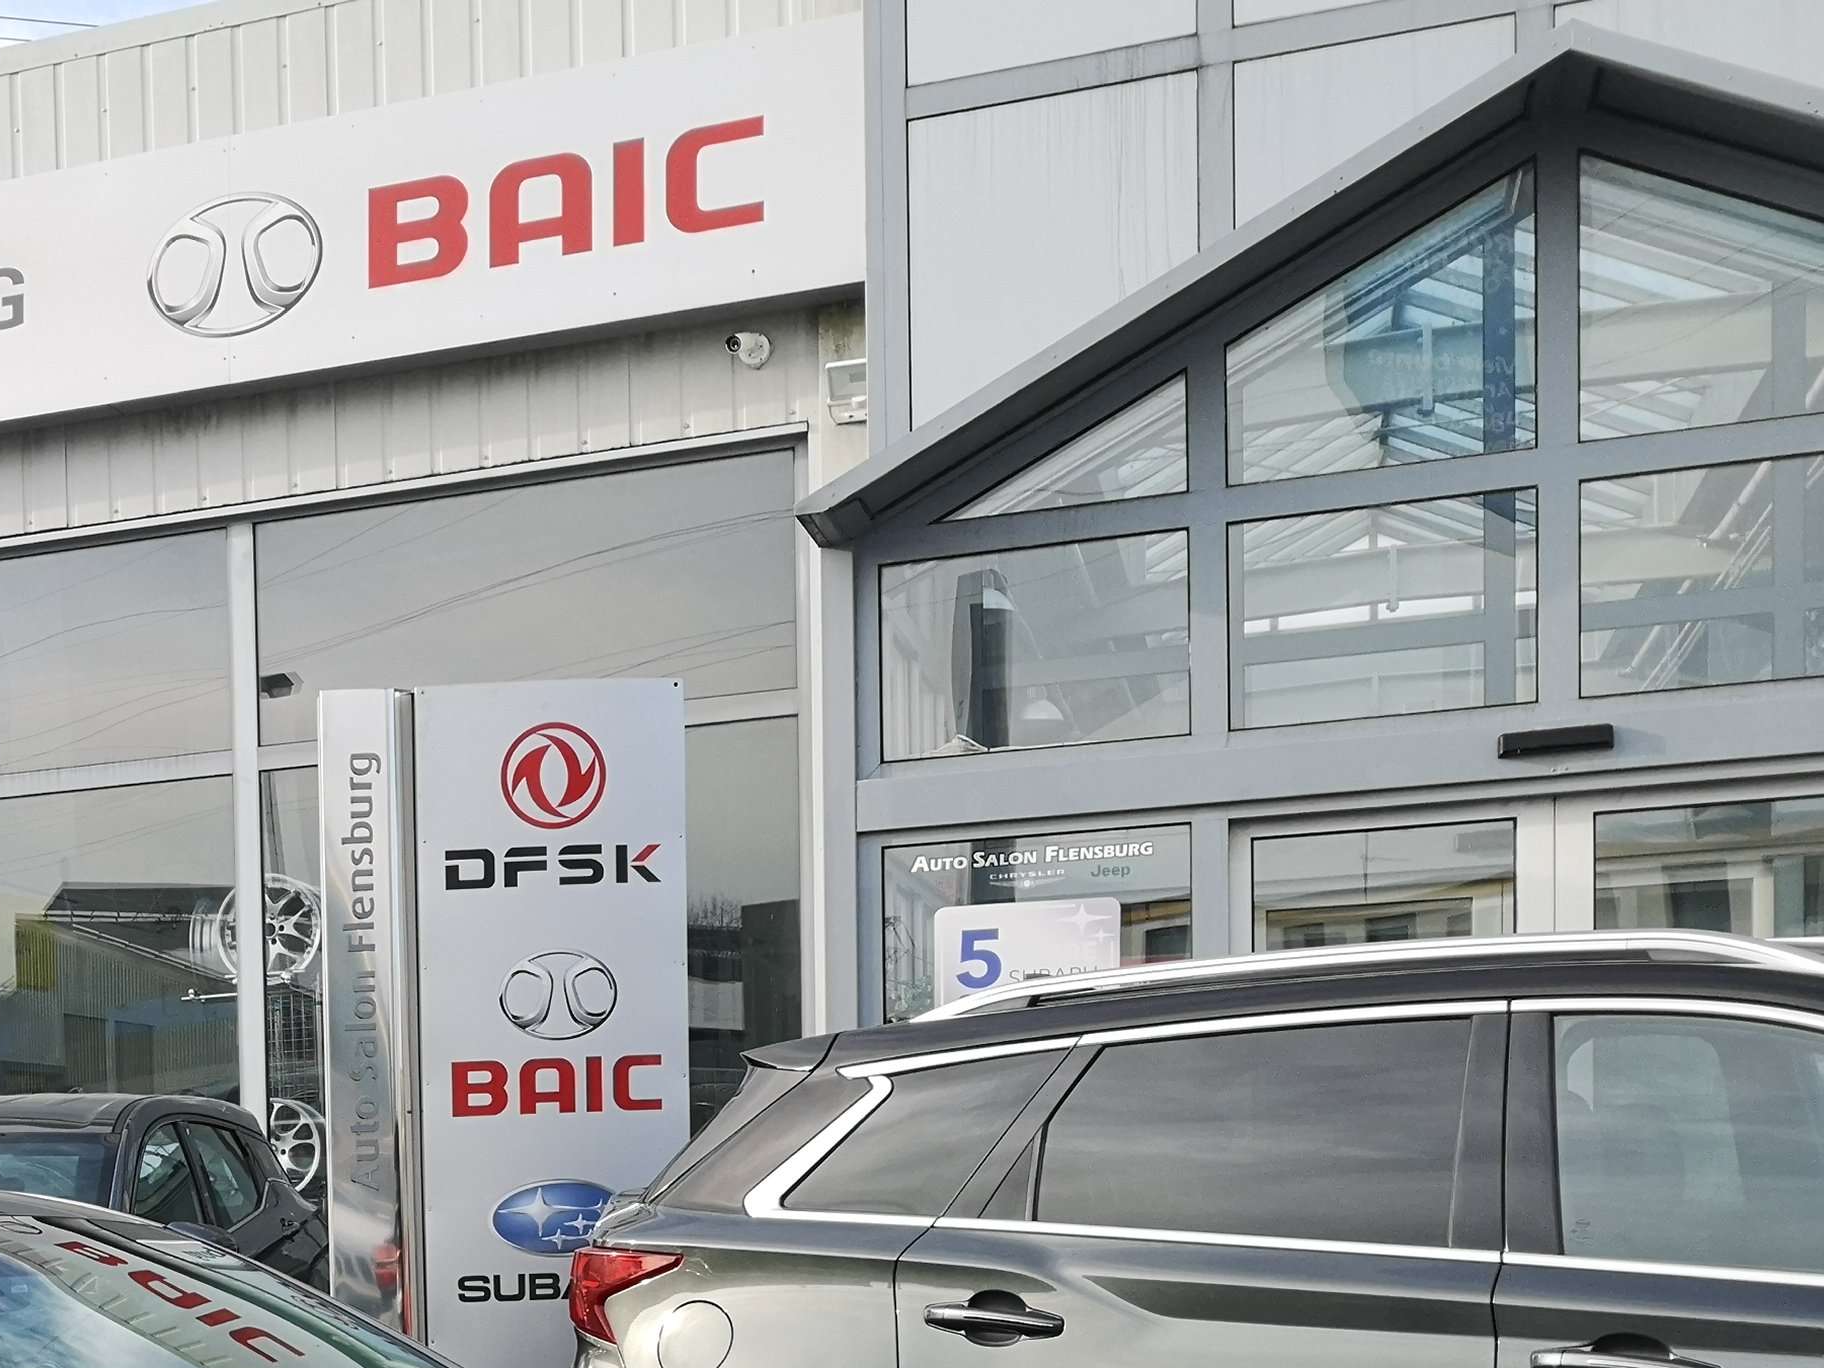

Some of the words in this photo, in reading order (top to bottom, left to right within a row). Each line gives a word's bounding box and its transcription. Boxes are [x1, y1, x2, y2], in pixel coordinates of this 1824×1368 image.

[368, 115, 764, 289] BAIC
[341, 752, 381, 953] Flensburg
[444, 844, 661, 890] DFSK
[989, 869, 1065, 880] CHRYSLER
[1091, 865, 1131, 878] Jeep
[956, 928, 1002, 988] 5
[344, 970, 378, 1081] Salon
[451, 1054, 663, 1117] BAIC
[351, 1098, 380, 1191] Auto
[458, 1274, 570, 1303] SUB
